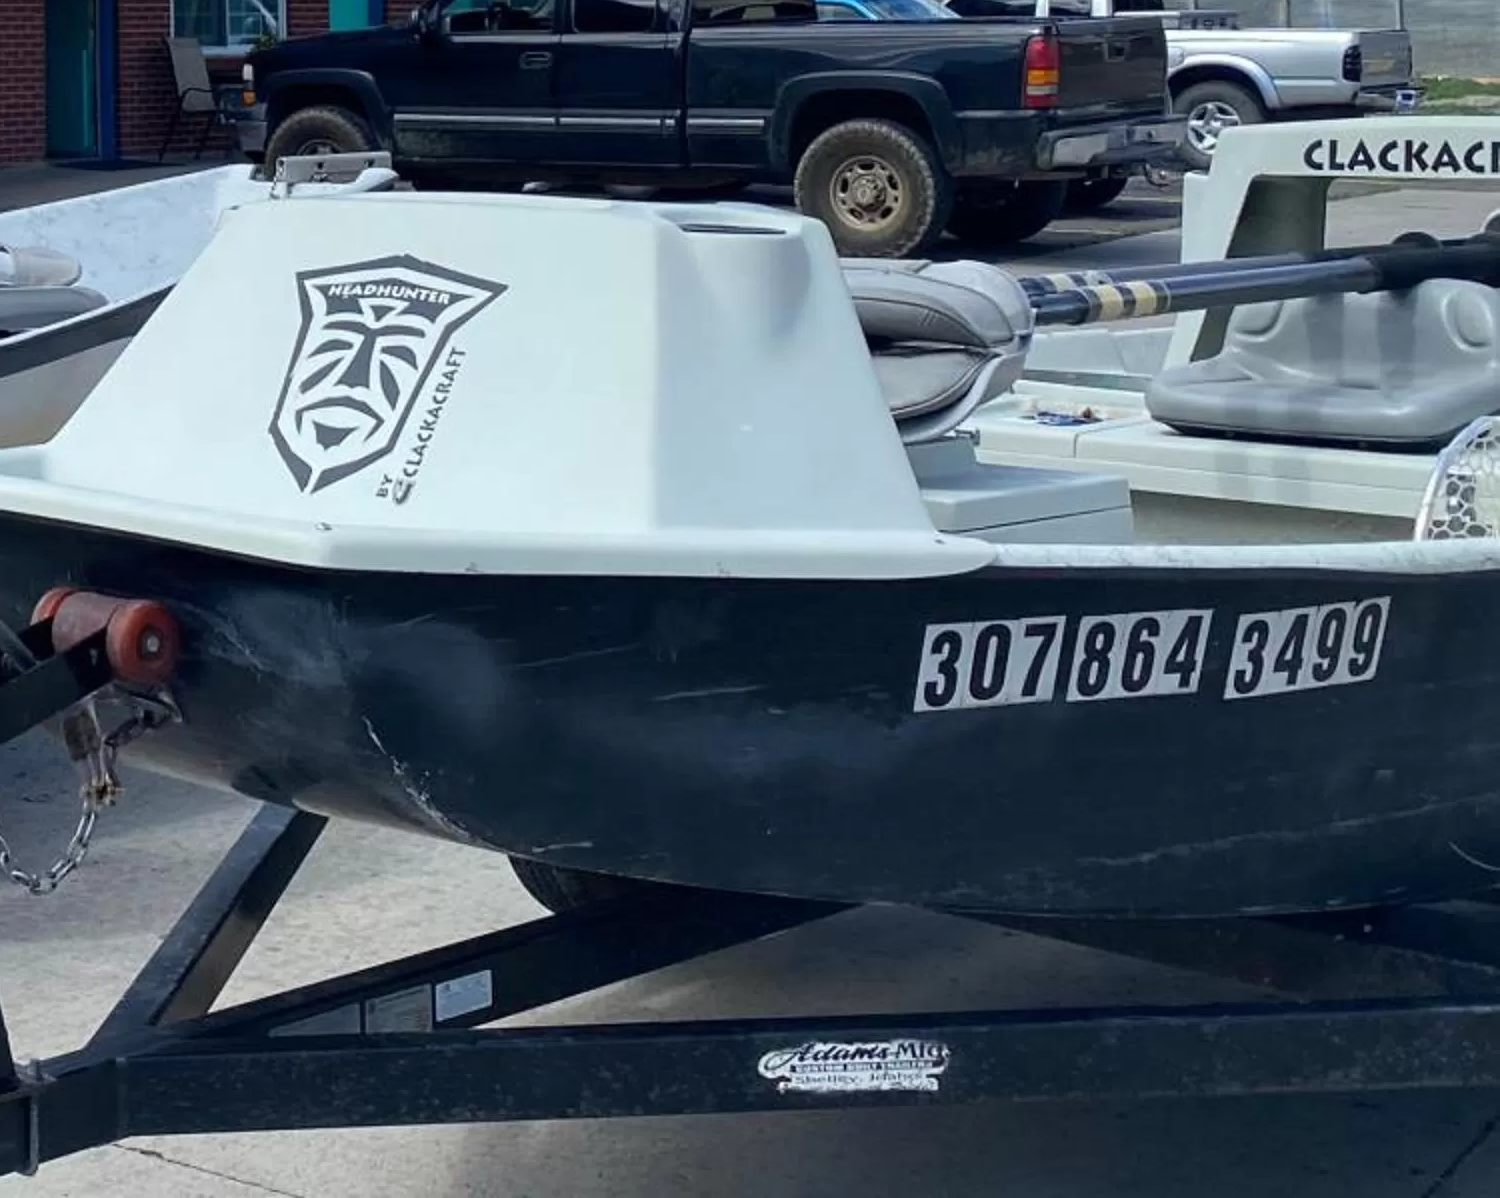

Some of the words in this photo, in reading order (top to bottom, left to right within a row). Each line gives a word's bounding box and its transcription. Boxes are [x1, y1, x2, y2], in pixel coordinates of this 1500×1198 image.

[328, 283, 451, 305] HEADHUNTER
[375, 473, 393, 498] BY
[402, 346, 466, 478] CLACKACRAFT
[924, 622, 1057, 708] 307
[1076, 615, 1204, 697] 864
[1233, 602, 1383, 695] 3499
